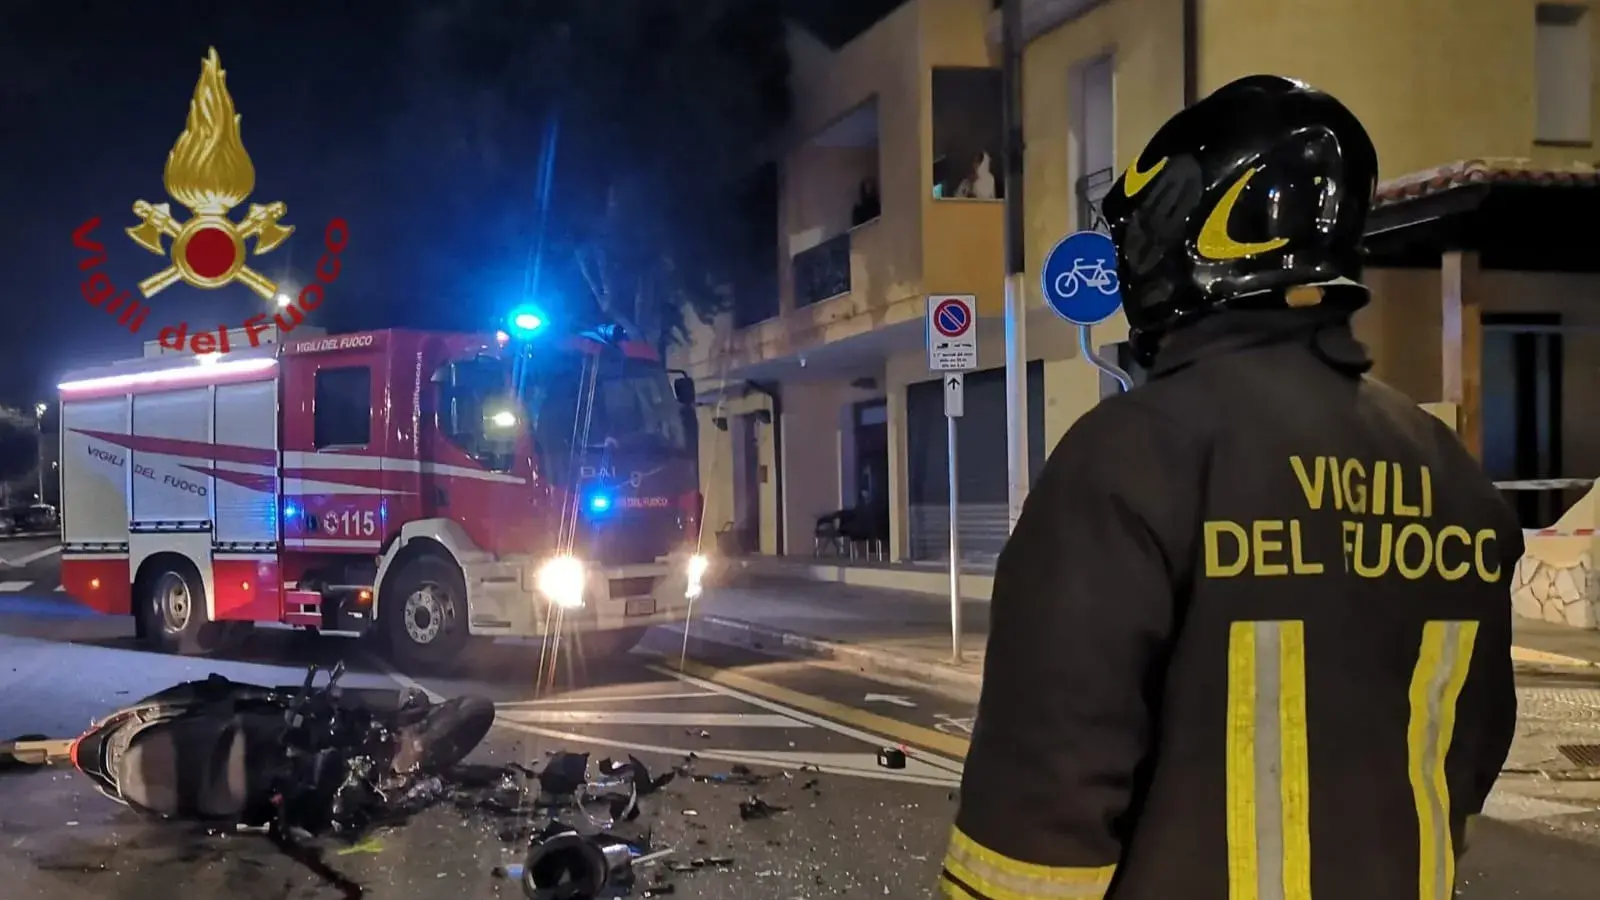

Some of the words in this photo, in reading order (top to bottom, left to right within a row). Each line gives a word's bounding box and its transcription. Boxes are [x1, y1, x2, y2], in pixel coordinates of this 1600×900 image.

[321, 339, 339, 351] DEL
[340, 335, 373, 349] FUOCO
[88, 444, 124, 467] VIGILI
[134, 463, 157, 480] DEL
[163, 474, 208, 497] FUOCO
[1289, 455, 1432, 518] VIGILI
[341, 510, 375, 536] 115
[1203, 519, 1324, 577] DEL
